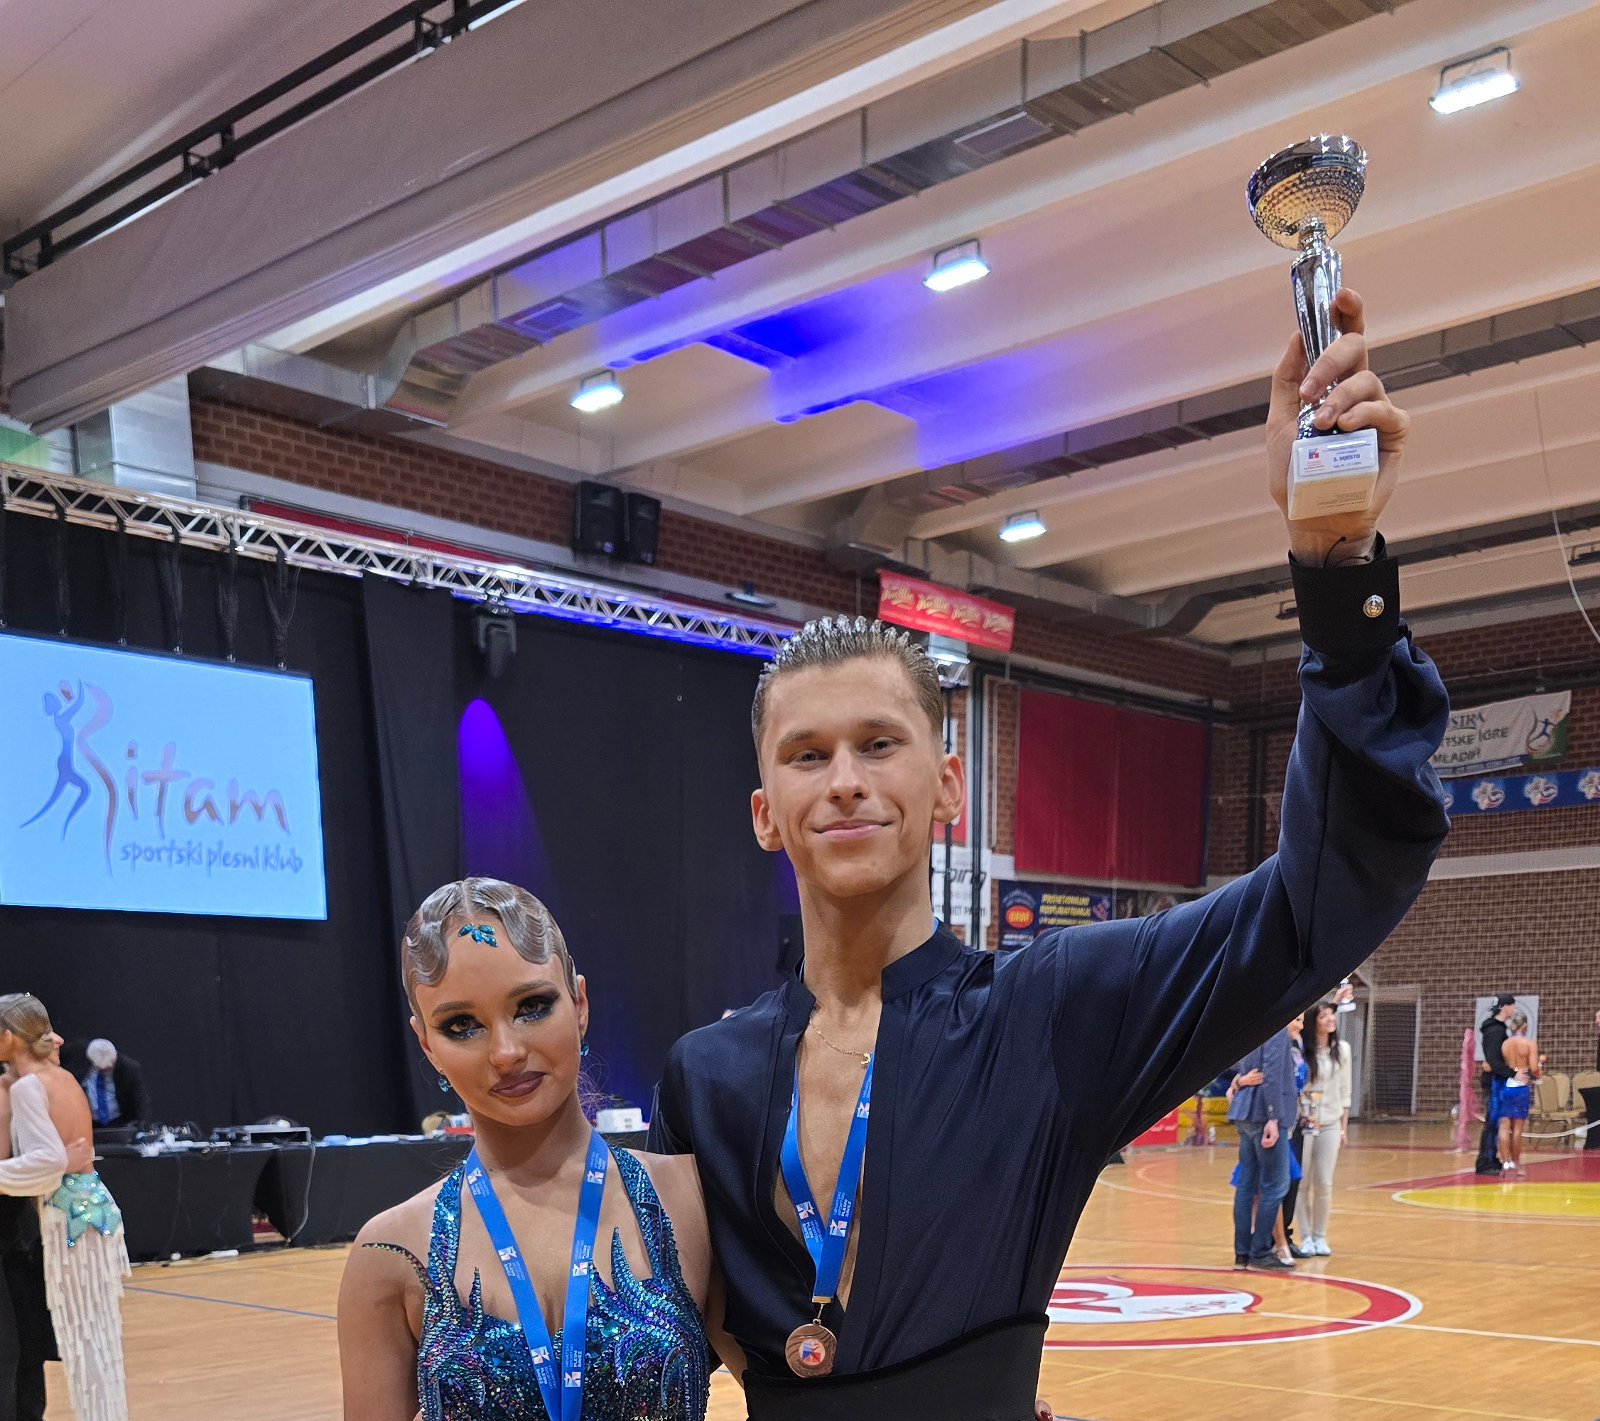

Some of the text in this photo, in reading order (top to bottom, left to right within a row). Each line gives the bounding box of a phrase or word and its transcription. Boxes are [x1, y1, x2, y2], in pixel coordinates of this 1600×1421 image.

[120, 838, 304, 877] sportski plesni klub
